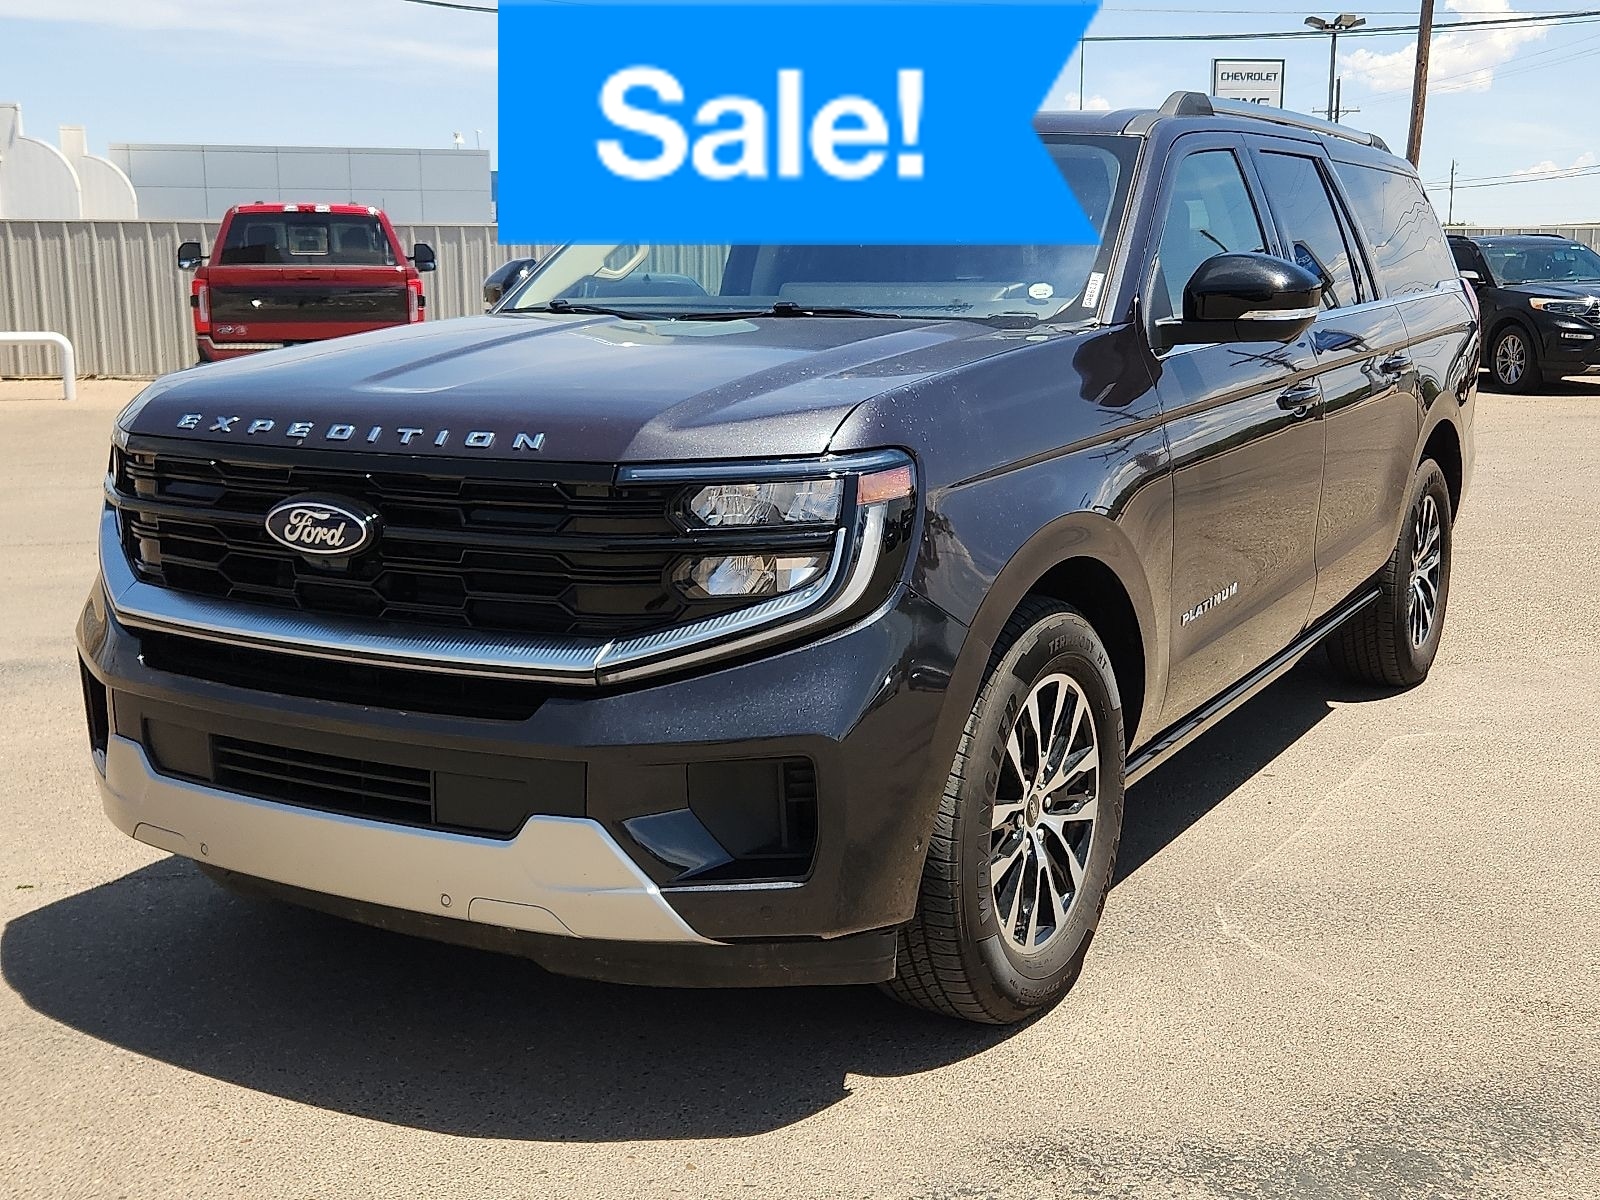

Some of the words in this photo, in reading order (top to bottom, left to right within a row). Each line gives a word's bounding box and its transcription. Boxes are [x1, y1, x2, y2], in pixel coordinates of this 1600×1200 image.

[1221, 72, 1278, 82] CHEVROLET
[177, 413, 546, 452] EXPEDITION
[284, 508, 346, 547] Ford
[1180, 582, 1238, 627] PLATINUM
[1097, 651, 1108, 669] HT
[977, 693, 1018, 925] WRANGLER
